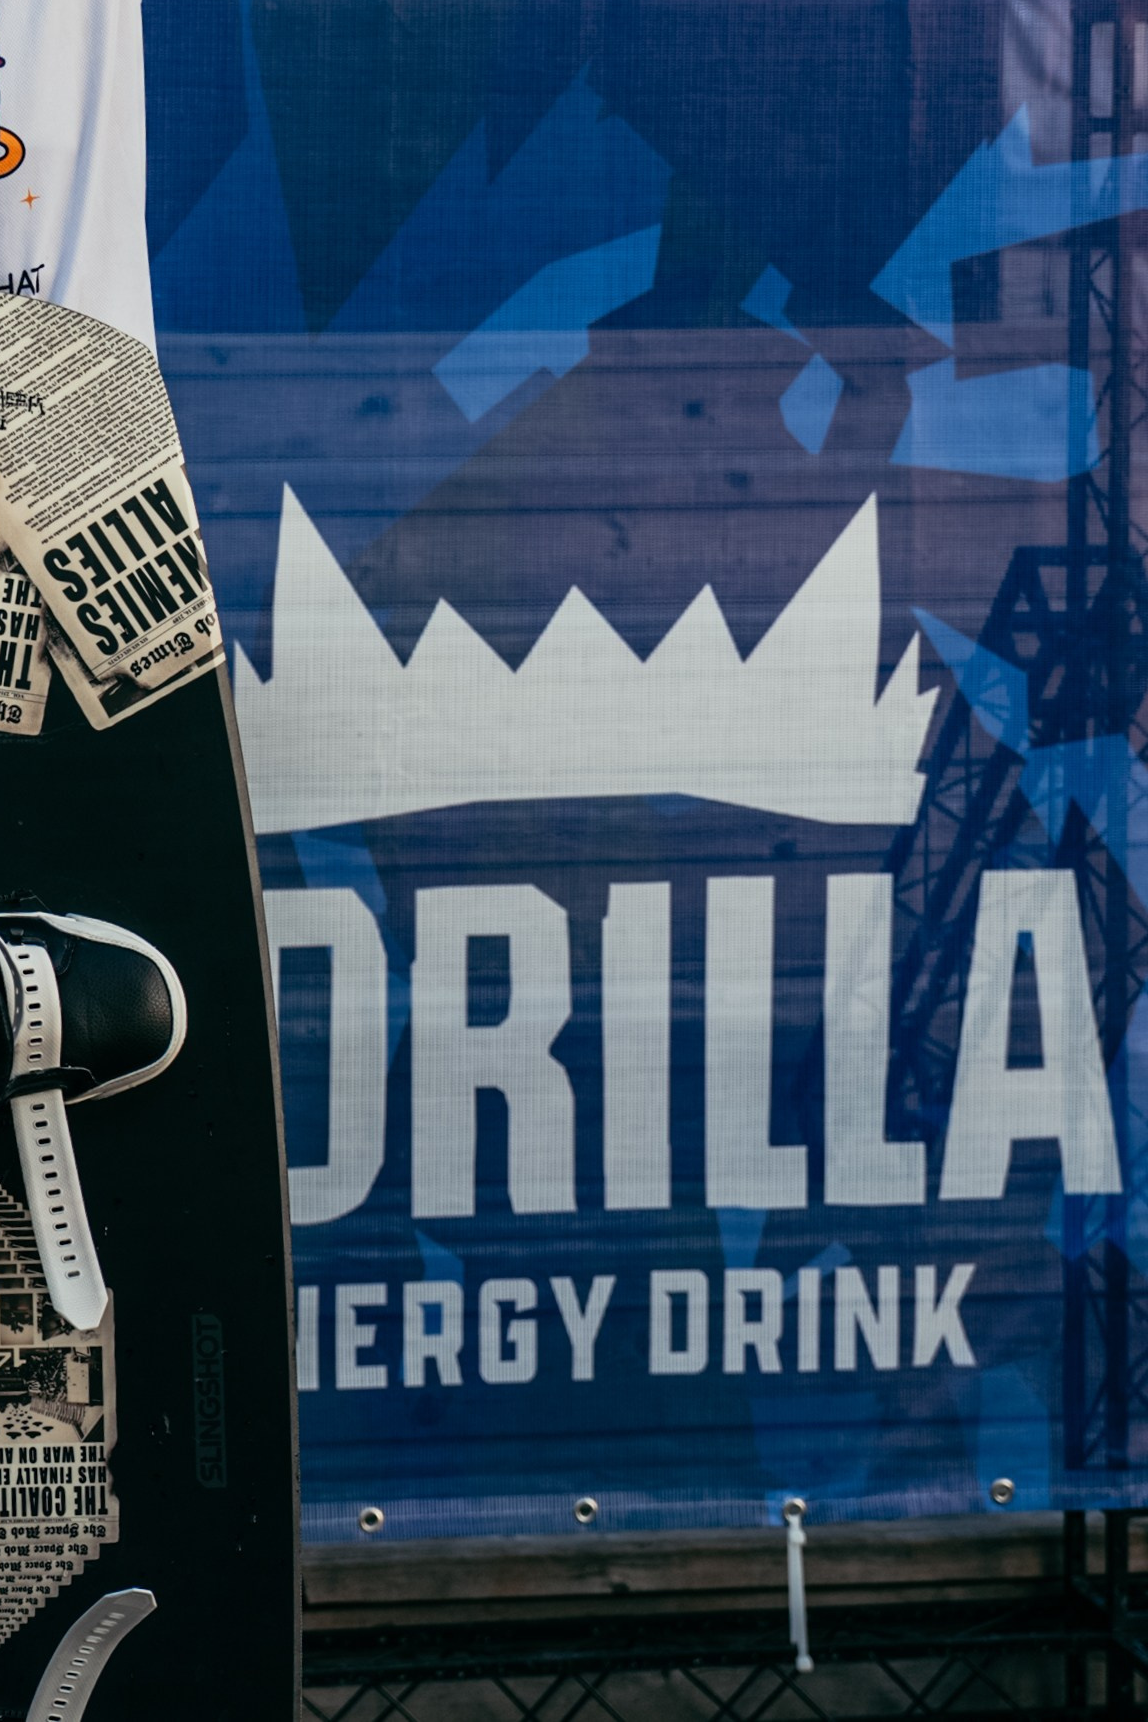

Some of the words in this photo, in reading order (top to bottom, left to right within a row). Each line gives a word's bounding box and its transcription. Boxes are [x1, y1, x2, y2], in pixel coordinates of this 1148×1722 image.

[42, 477, 188, 602] ALLIES
[1, 577, 43, 609] THE
[129, 631, 195, 678] Times
[647, 1263, 976, 1376] DRINK
[197, 1320, 223, 1483] SLINGSHOT
[18, 1446, 37, 1464] ON
[42, 1445, 74, 1463] WAR
[79, 1444, 105, 1463] THE
[15, 1465, 72, 1484] FINALLY
[77, 1465, 106, 1483] HAS
[72, 1484, 108, 1516] THE
[10, 1523, 40, 1539] Mob
[43, 1523, 79, 1539] Space
[82, 1522, 106, 1538] The
[3, 1543, 29, 1556] Mob
[33, 1543, 64, 1556] Space
[67, 1542, 88, 1555] The
[24, 1560, 52, 1572] Space
[54, 1559, 73, 1571] The
